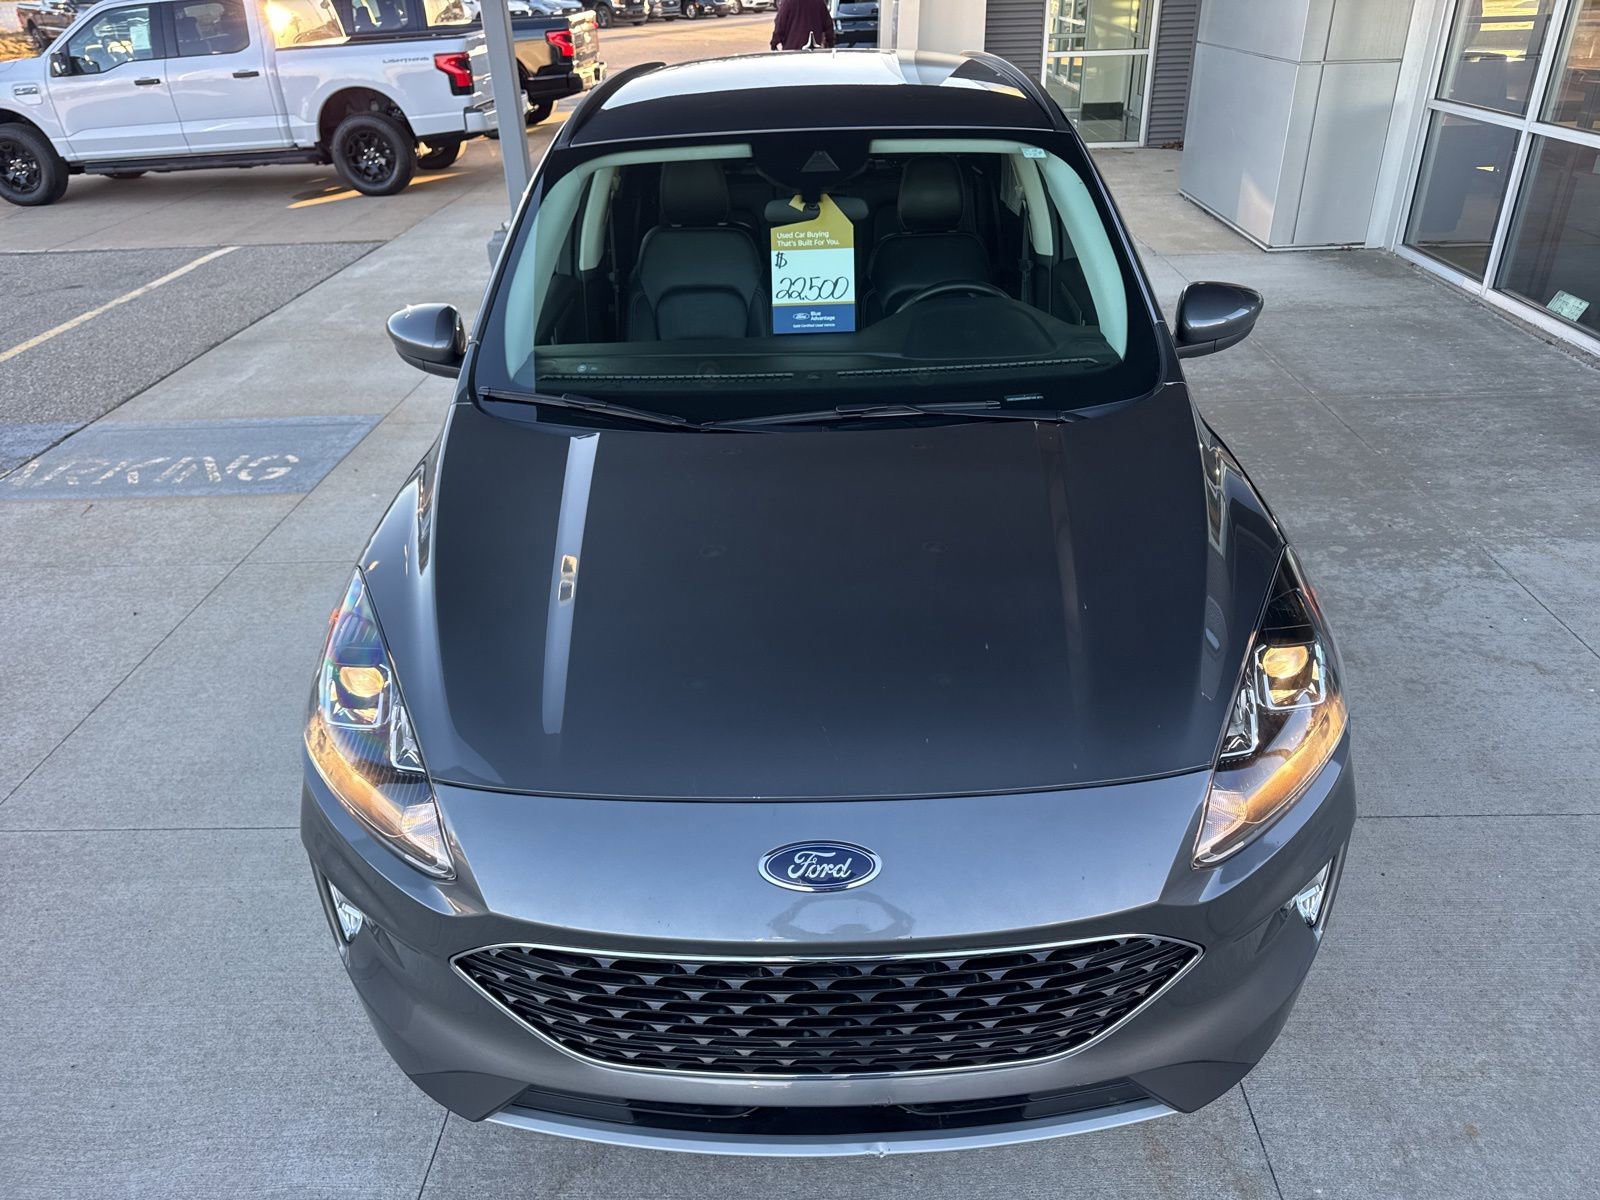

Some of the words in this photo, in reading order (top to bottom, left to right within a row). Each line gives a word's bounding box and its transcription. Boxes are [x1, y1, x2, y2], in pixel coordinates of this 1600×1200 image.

[776, 231, 793, 239] Used
[806, 231, 830, 239] Buying
[797, 239, 813, 247] Built
[826, 238, 840, 246] You.
[787, 850, 853, 879] Ford
